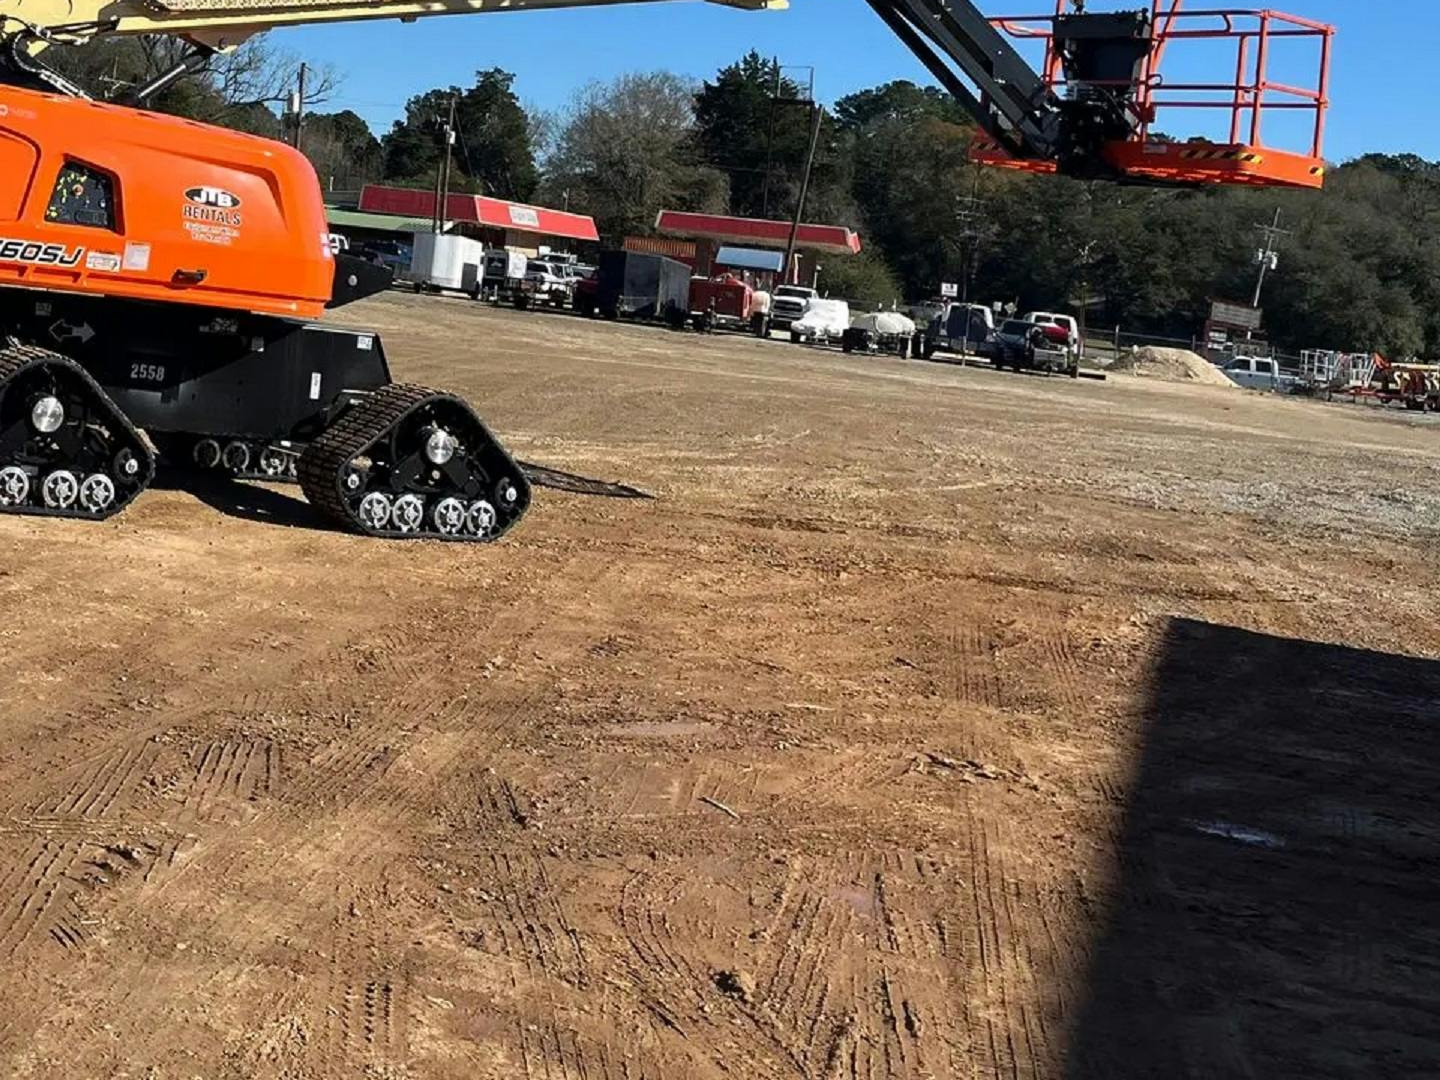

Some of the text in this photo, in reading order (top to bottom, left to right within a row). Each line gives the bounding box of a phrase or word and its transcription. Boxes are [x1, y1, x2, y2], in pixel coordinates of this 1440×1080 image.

[192, 188, 234, 207] JTB
[183, 204, 242, 226] RENTALS
[129, 362, 166, 382] 2558
